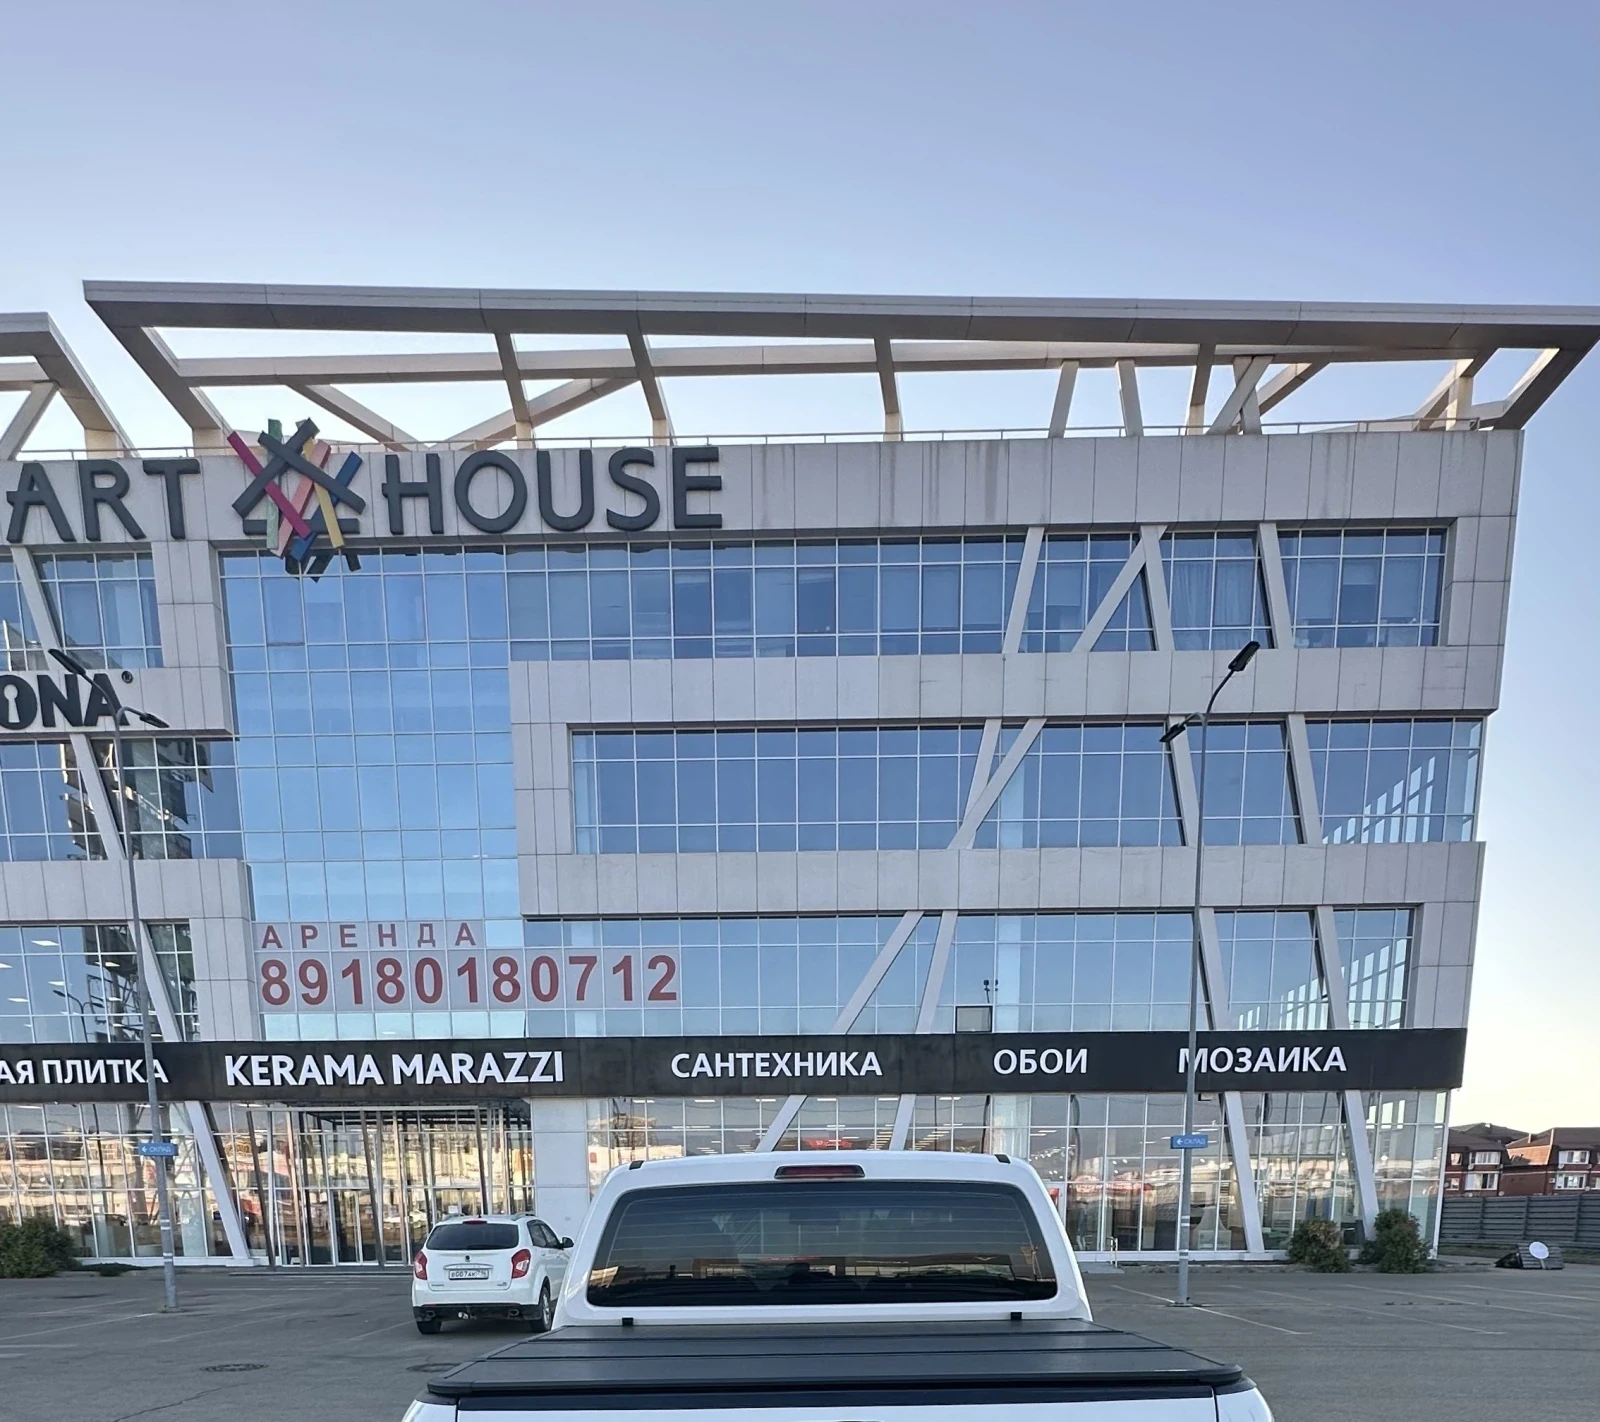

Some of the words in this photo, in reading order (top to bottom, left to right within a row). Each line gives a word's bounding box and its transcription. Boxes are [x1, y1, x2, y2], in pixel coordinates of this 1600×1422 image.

[5, 458, 201, 544] ART
[380, 446, 724, 535] HOUSE
[260, 922, 477, 949] АРЕНДА
[260, 954, 678, 1006] 89180180712
[42, 1058, 170, 1085] ПЛИТКА
[225, 1053, 385, 1087] KERAMA
[392, 1050, 564, 1084] MARAZZI
[671, 1051, 883, 1078] САНТЕХНИКА
[993, 1048, 1088, 1075] ОБОИ
[1178, 1046, 1347, 1074] МОЗАИКА
